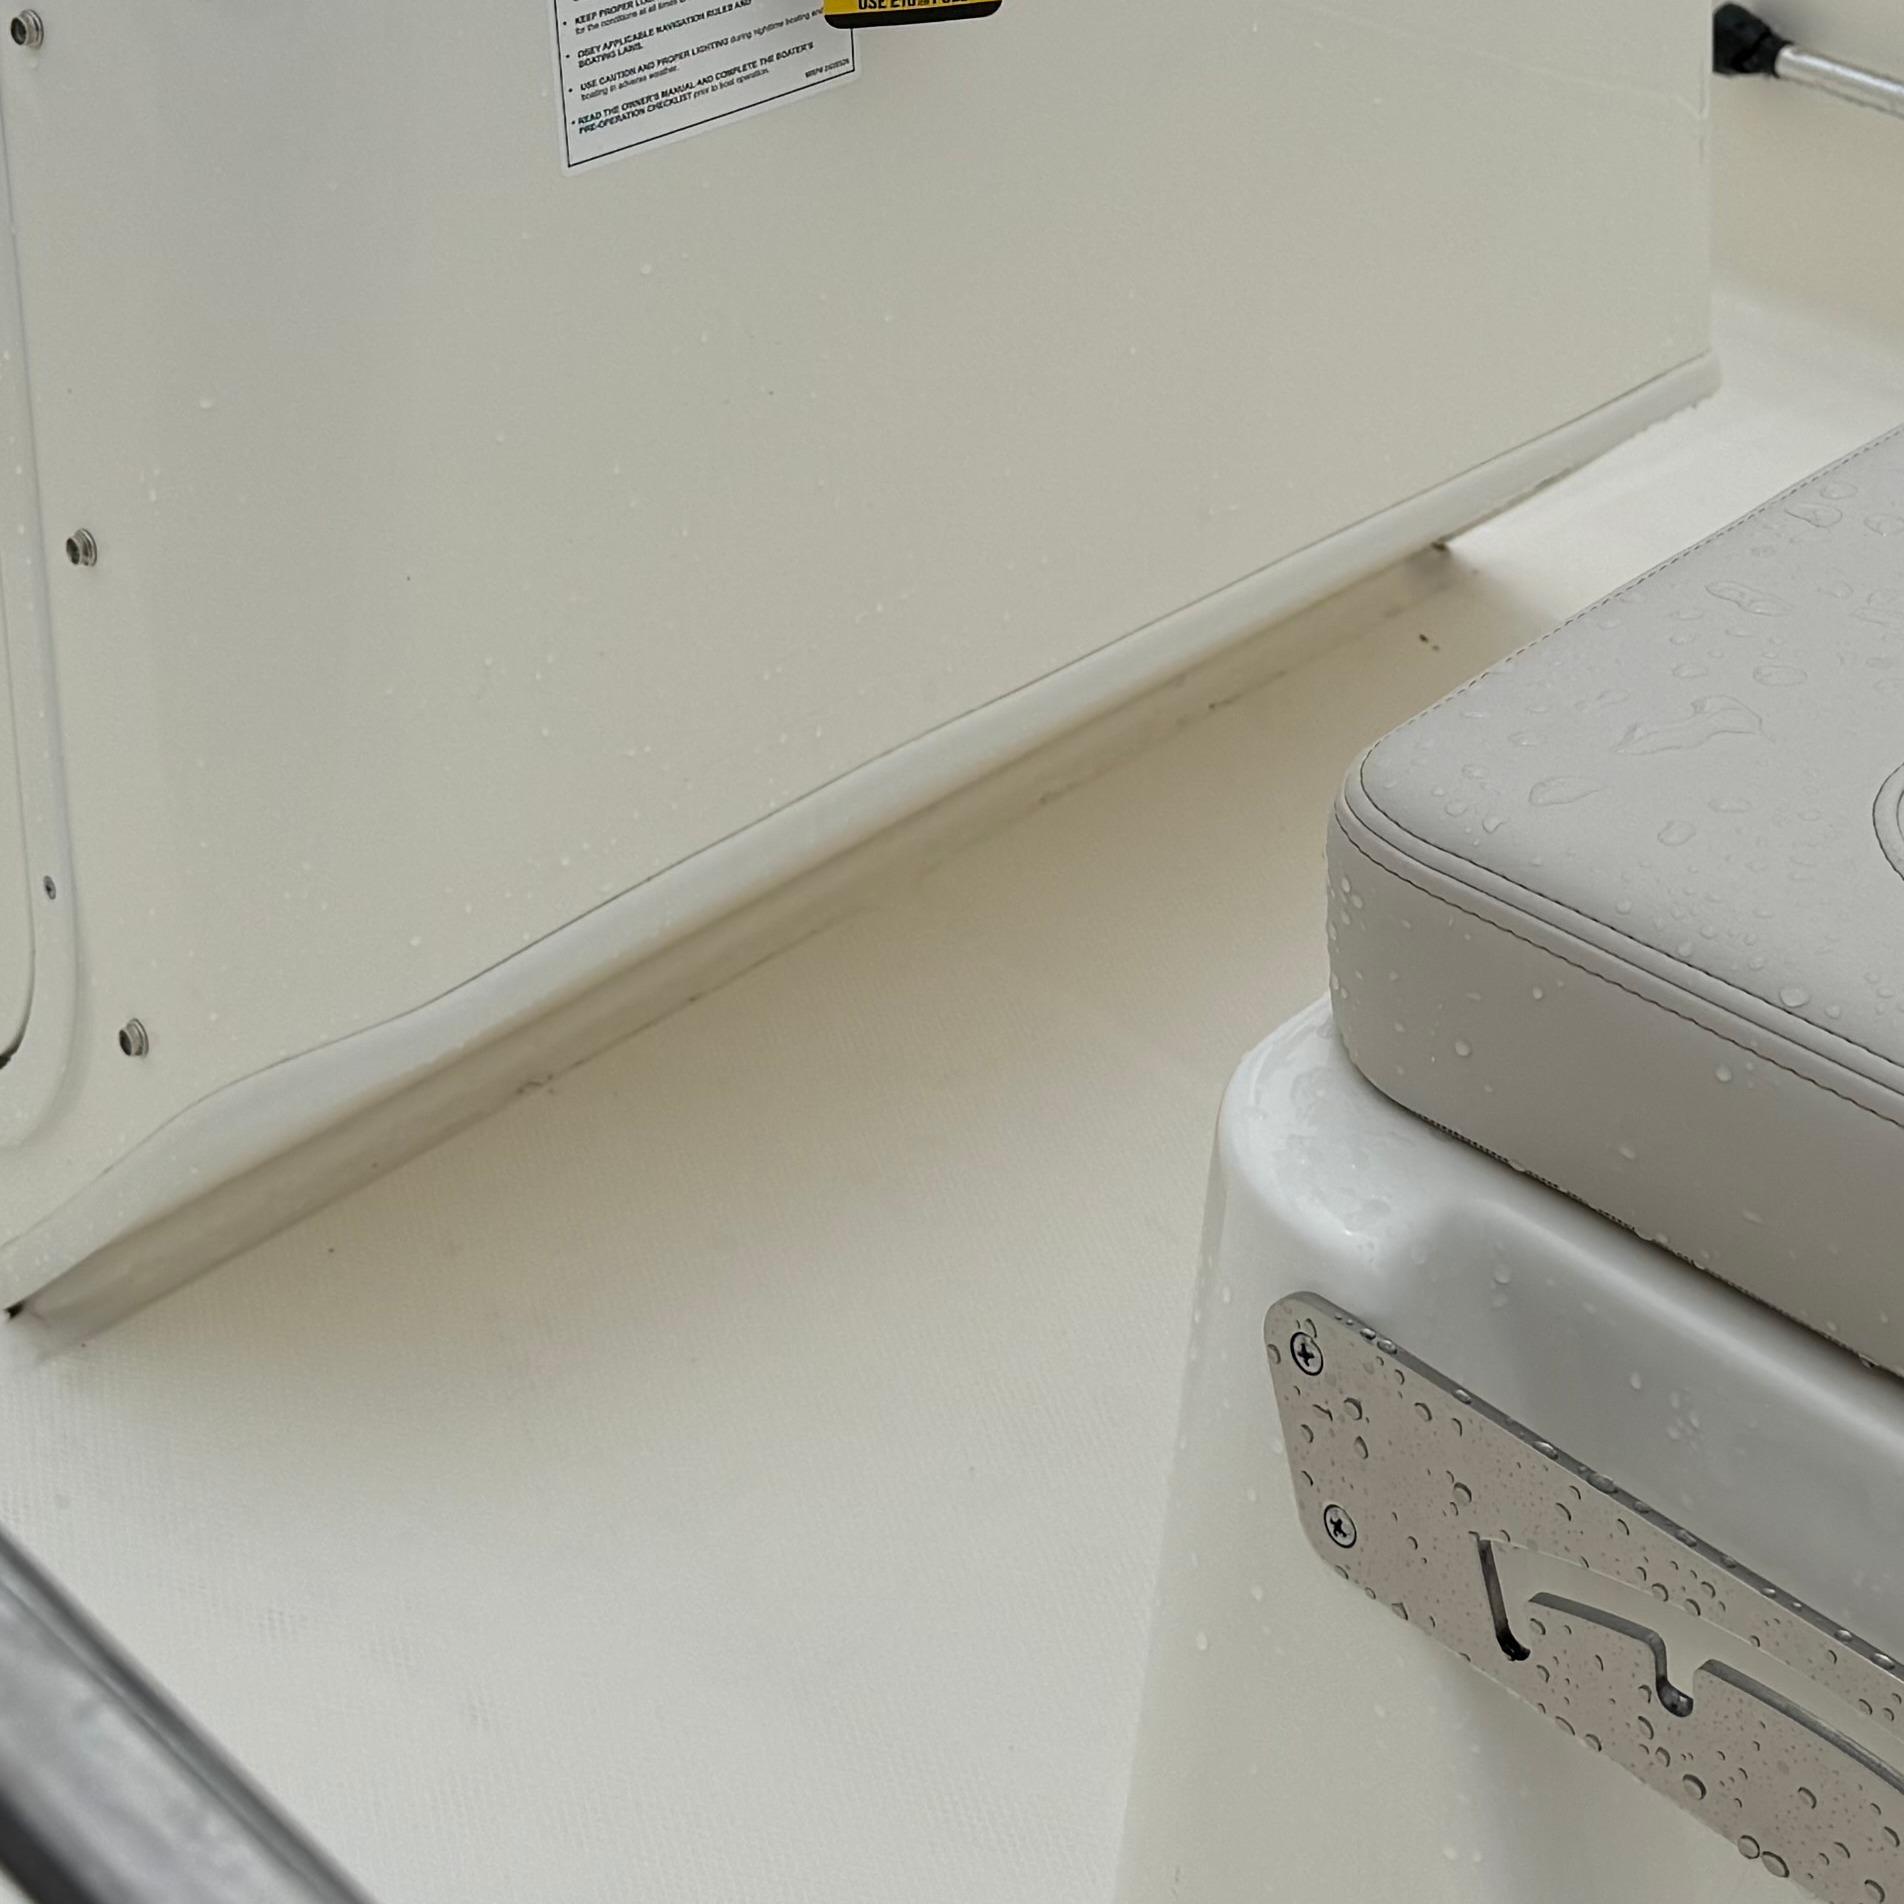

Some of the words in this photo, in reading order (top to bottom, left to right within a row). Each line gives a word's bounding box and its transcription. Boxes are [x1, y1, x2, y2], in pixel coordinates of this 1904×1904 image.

[574, 11, 596, 27] KEEP
[598, 0, 633, 19] PROPER
[579, 78, 598, 93] USE
[599, 66, 637, 86] CAUTION
[636, 60, 656, 74] AND
[656, 49, 690, 68] PROPER
[691, 36, 729, 56] LIGHTING
